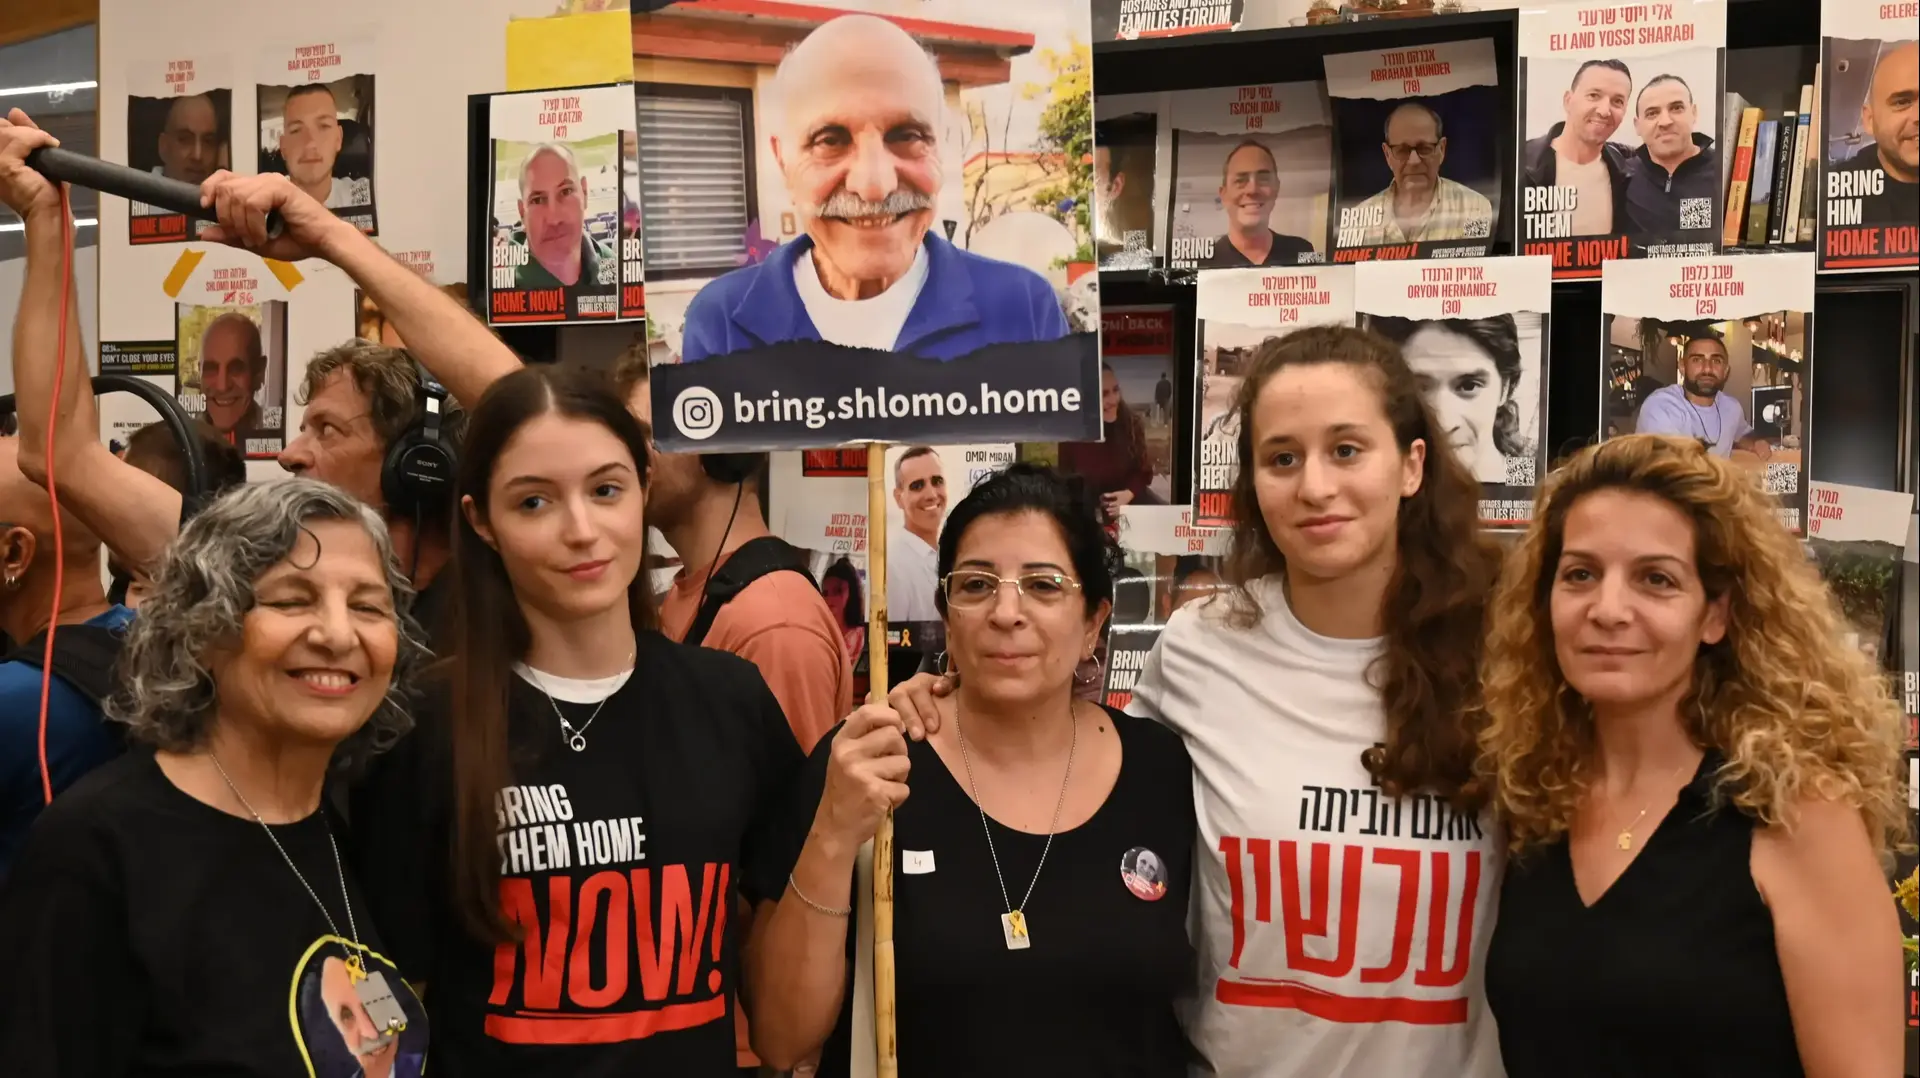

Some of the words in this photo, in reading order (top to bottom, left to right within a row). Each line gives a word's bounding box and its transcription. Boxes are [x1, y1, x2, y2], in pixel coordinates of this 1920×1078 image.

[1120, 0, 1168, 13] HOSTAGES
[1620, 6, 1648, 23] ויוסי
[1652, 4, 1673, 21] אלי
[1119, 10, 1179, 33] FAMILIES
[1181, 5, 1231, 28] FORUM
[1578, 8, 1616, 27] שרעבי
[1550, 34, 1567, 51] ELI
[1570, 31, 1595, 49] AND
[1599, 28, 1634, 47] YOSSI
[1638, 24, 1694, 44] SHARABI
[1371, 65, 1413, 82] ABRAHAM
[1415, 62, 1451, 77] MUNDER
[1403, 79, 1420, 94] (78)
[1229, 101, 1259, 115] TSACHI
[1260, 100, 1280, 113] IDAN
[539, 112, 556, 125] ELAD
[558, 110, 582, 123] KATZIR
[553, 125, 568, 140] (47)
[1827, 169, 1884, 198] BRING
[1524, 185, 1577, 212] BRING
[1340, 206, 1383, 228] BRING
[1827, 198, 1862, 226] HIM
[1524, 213, 1571, 239] THEM
[1337, 228, 1365, 248] HIM
[1826, 228, 1880, 257] HOME
[492, 245, 529, 267] BRING
[1172, 237, 1214, 260] BRING
[1577, 235, 1628, 266] NOW!
[1647, 245, 1676, 253] HOSTAGES
[1676, 244, 1688, 252] AND
[1688, 243, 1714, 252] MISSING
[492, 267, 515, 289] HIM
[1681, 265, 1709, 282] כלפון
[1712, 265, 1733, 280] שגב
[205, 281, 230, 291] SHLOMO
[1262, 276, 1299, 290] ירושלמי
[1301, 276, 1317, 290] עדן
[1408, 284, 1439, 298] ORYON
[1442, 282, 1497, 297] HERNANDEZ
[1669, 283, 1702, 298] SEGEV
[1704, 281, 1744, 297] KALFON
[493, 290, 526, 313] HOME
[529, 287, 565, 312] NOW!
[1248, 293, 1271, 306] EDEN
[1273, 291, 1330, 306] YERUSHALMI
[1442, 299, 1461, 315] (30)
[1280, 307, 1299, 323] (24)
[1696, 299, 1717, 316] (25)
[101, 353, 120, 364] DON'T
[121, 353, 141, 363] CLOSE
[142, 353, 159, 363] YOUR
[159, 352, 175, 363] EYES
[733, 382, 1081, 430] bring.shlomo.home
[965, 450, 987, 463] OMRI
[989, 452, 1013, 463] MIRAN
[1201, 440, 1239, 465] BRIN
[416, 459, 439, 469] SONY
[1200, 465, 1230, 490] HER
[1816, 504, 1843, 521] ADAR
[825, 526, 853, 537] DANIELA
[1188, 540, 1204, 552] (53)
[1109, 670, 1136, 689] HIM
[1299, 785, 1401, 837] הביתה
[496, 823, 571, 875] THEM
[573, 817, 646, 867] HOME
[1218, 835, 1481, 987] עכשיו
[487, 862, 730, 1009] NOW!
